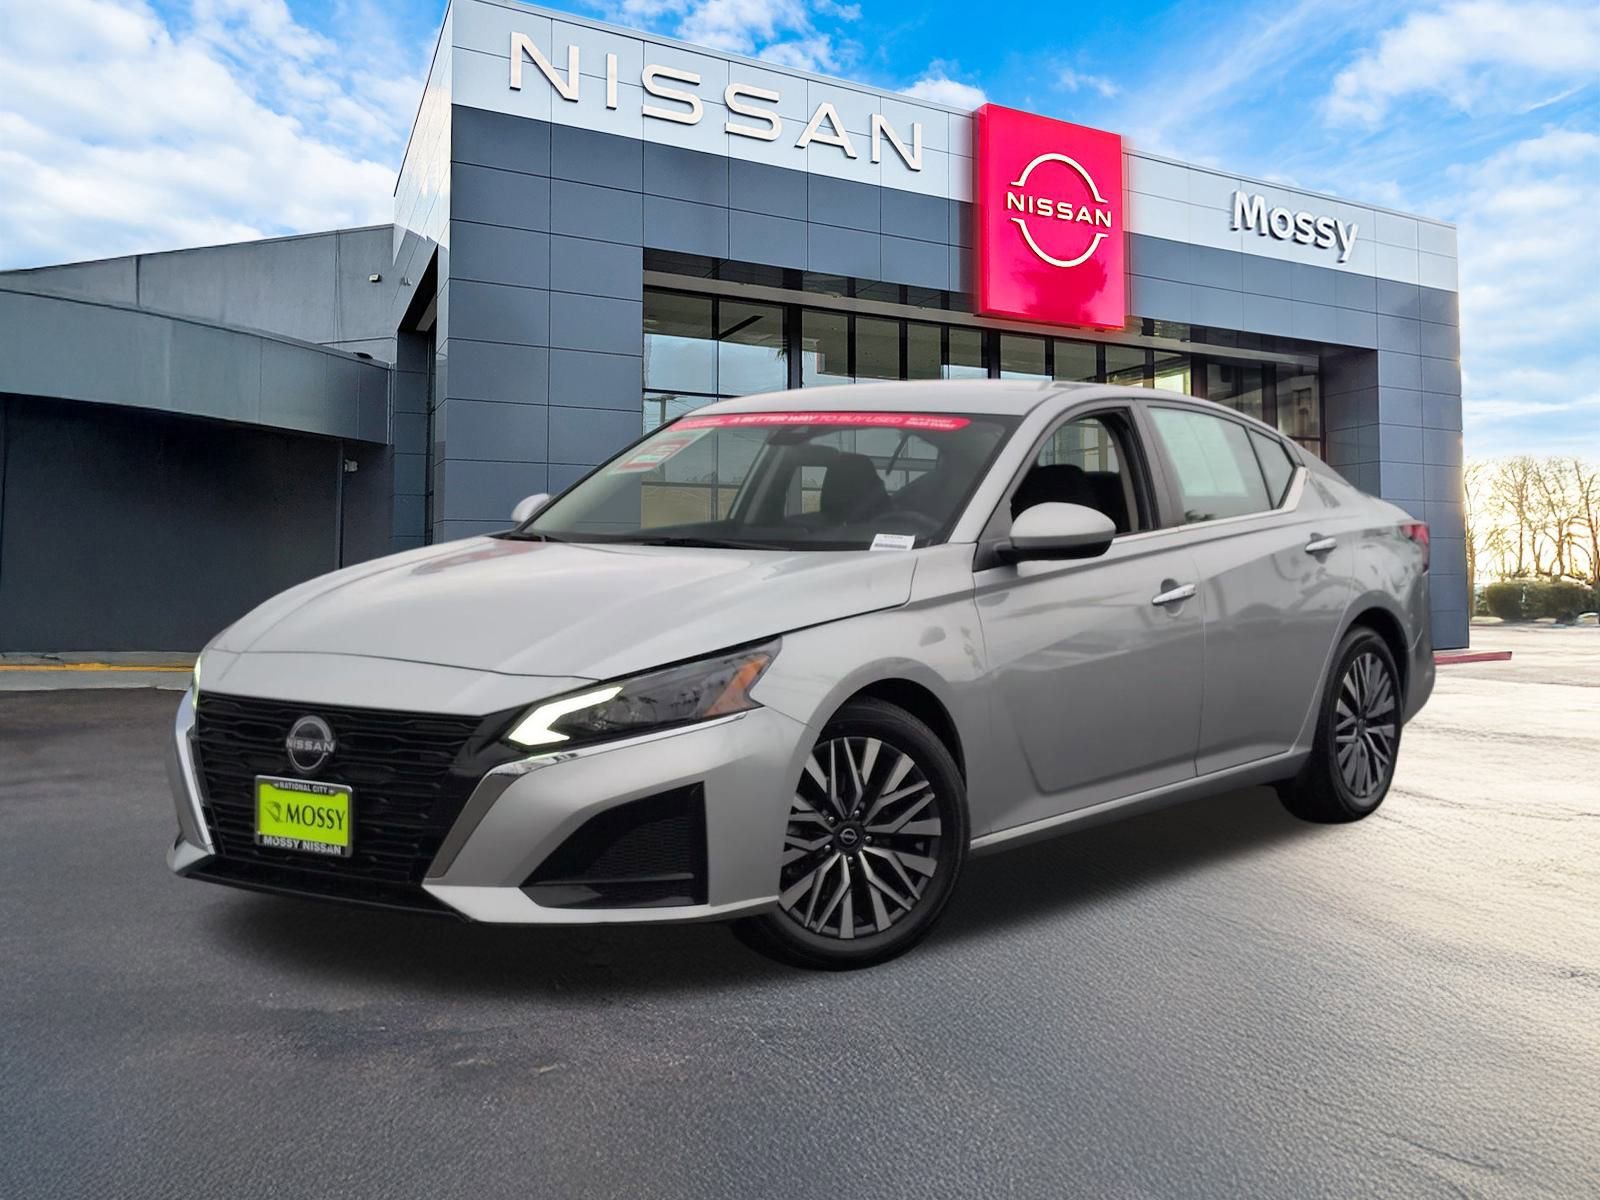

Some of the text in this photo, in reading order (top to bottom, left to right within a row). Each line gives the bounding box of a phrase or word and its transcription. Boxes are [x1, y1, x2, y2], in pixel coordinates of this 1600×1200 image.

[509, 31, 922, 172] NISSAN
[1006, 191, 1112, 228] NISSAN
[1230, 190, 1360, 263] Mossy
[286, 737, 335, 753] NISSAN
[279, 781, 328, 793] NATIONAL CITY
[286, 802, 346, 831] MOSSY
[263, 836, 341, 855] MOSSY NISSAN
